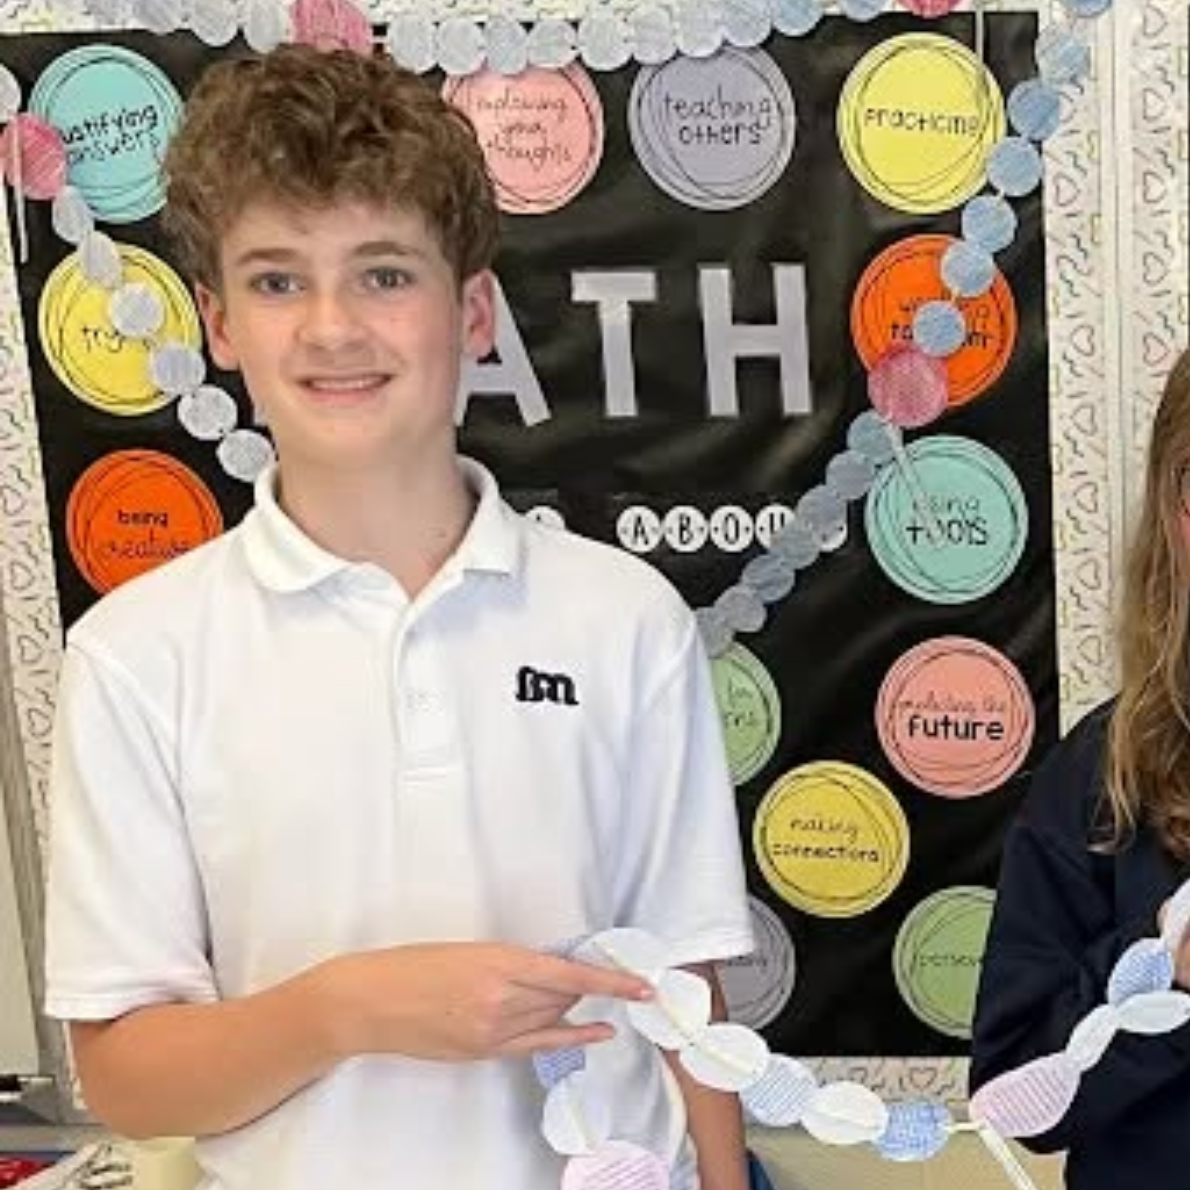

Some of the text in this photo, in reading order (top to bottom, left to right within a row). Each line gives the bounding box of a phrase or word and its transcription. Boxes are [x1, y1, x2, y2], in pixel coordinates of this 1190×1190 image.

[664, 84, 771, 129] teaching
[59, 103, 158, 146] ustifying
[680, 124, 761, 145] others
[454, 262, 813, 427] ATH
[117, 508, 168, 529] being
[905, 516, 988, 546] tools
[909, 714, 1004, 740] future
